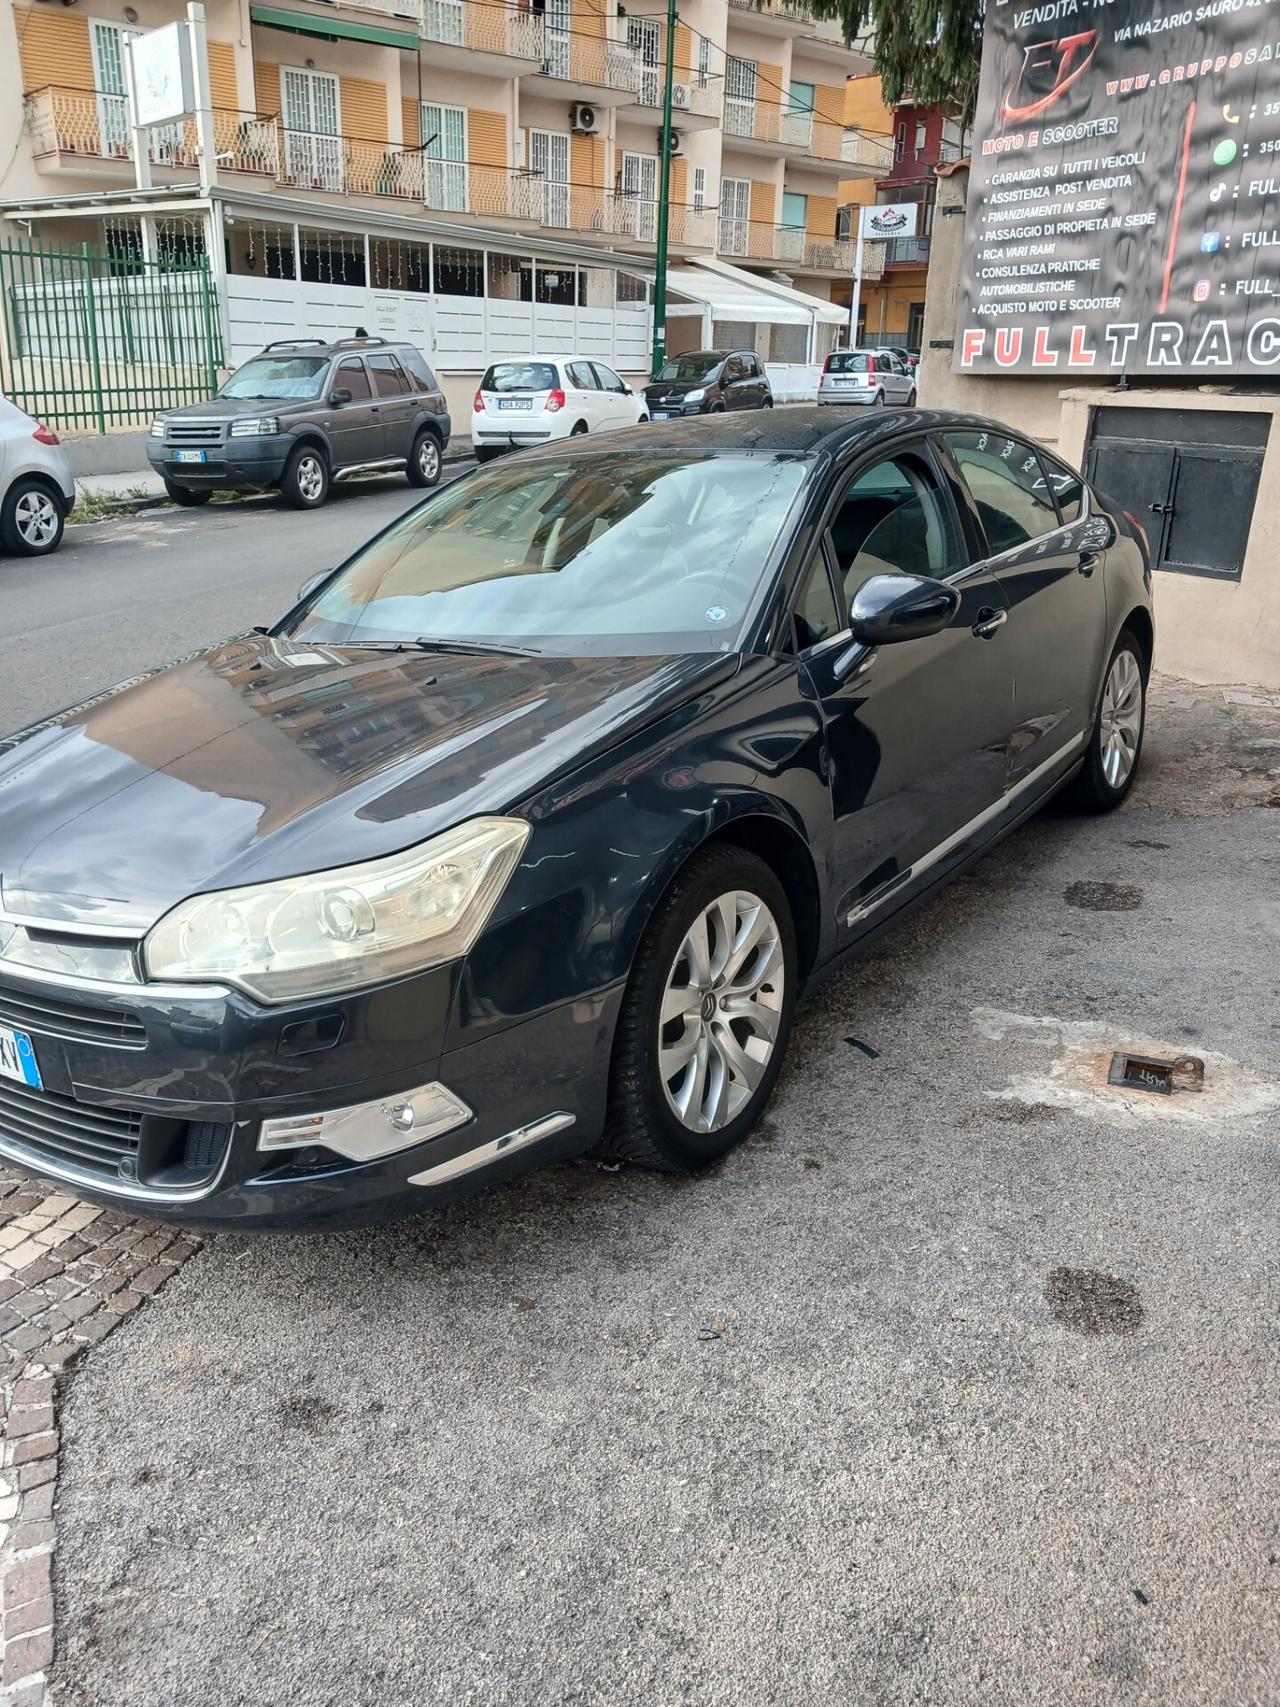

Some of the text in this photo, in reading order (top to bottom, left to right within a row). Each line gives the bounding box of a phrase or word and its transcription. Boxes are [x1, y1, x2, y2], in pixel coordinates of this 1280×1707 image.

[1014, 0, 1078, 29] VENDITA
[1114, 0, 1243, 42] VIA NAZARIO SAURO
[982, 117, 1118, 156] MOTO E SCOOTER
[992, 165, 1042, 186] GARANZIA
[1043, 163, 1057, 178] SU
[1063, 160, 1092, 177] TUTTI
[1100, 151, 1146, 169] VEICOLI
[990, 175, 1132, 205] ASSISTENZA POST VENDITA
[1248, 178, 1280, 197] FUL
[988, 198, 1107, 224] FINANZIAMENTI IN SEDE
[985, 212, 1157, 242] PASSAGGIO DI PROPIETA IN SEDE
[983, 243, 1056, 260] RCA VARI RAMI
[981, 258, 1101, 279] CONSULENZA PRATICHE
[980, 280, 1076, 297] AUTOMOBILISTICHE
[977, 297, 1121, 317] ACQUISTO MOTO E SCOOTER
